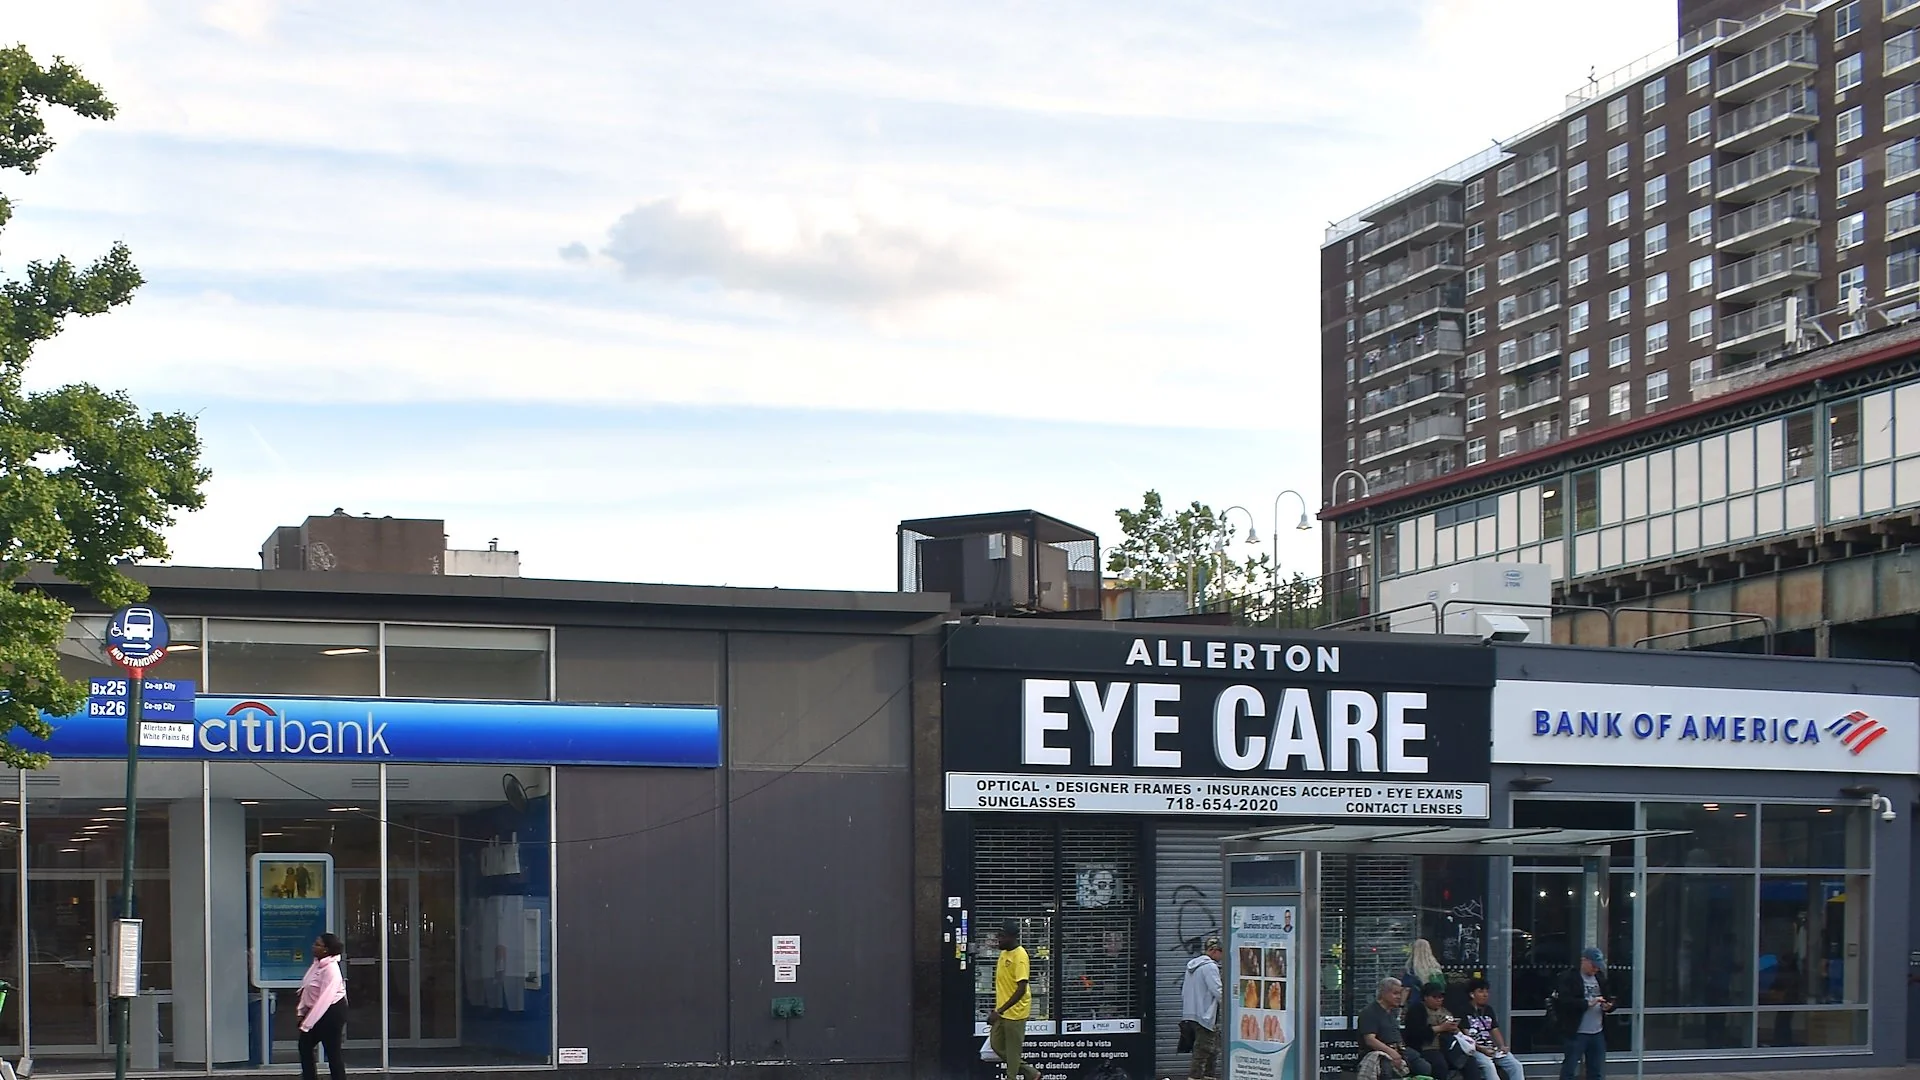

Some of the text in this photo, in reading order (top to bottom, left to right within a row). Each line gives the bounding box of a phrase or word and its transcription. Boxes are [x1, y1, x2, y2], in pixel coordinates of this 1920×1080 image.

[110, 647, 164, 667] NO STANDING
[1126, 639, 1341, 673] ALLERTON
[91, 680, 127, 696] Bx25
[145, 681, 176, 692] Co-op City
[90, 700, 126, 716] Bx26
[144, 702, 176, 712] Co-op City
[143, 724, 167, 732] Allerton
[198, 708, 391, 755] citibank
[1022, 678, 1429, 774] EYE CARE
[1532, 709, 1821, 745] BANK OF AMERICA
[161, 733, 180, 741] Plains
[181, 734, 190, 742] Rd
[976, 779, 1464, 800] OPTICAL DESIGNER FRAMES INSURANCES ACCEPTED EYE EXAMS
[977, 796, 1077, 809] SUNGLASSES
[1166, 797, 1279, 812] 718-654-2020
[1345, 802, 1464, 815] CONTACT LENSES
[1038, 1040, 1075, 1048] completos
[1101, 1052, 1129, 1060] seguros
[1045, 1061, 1081, 1069] diseñador
